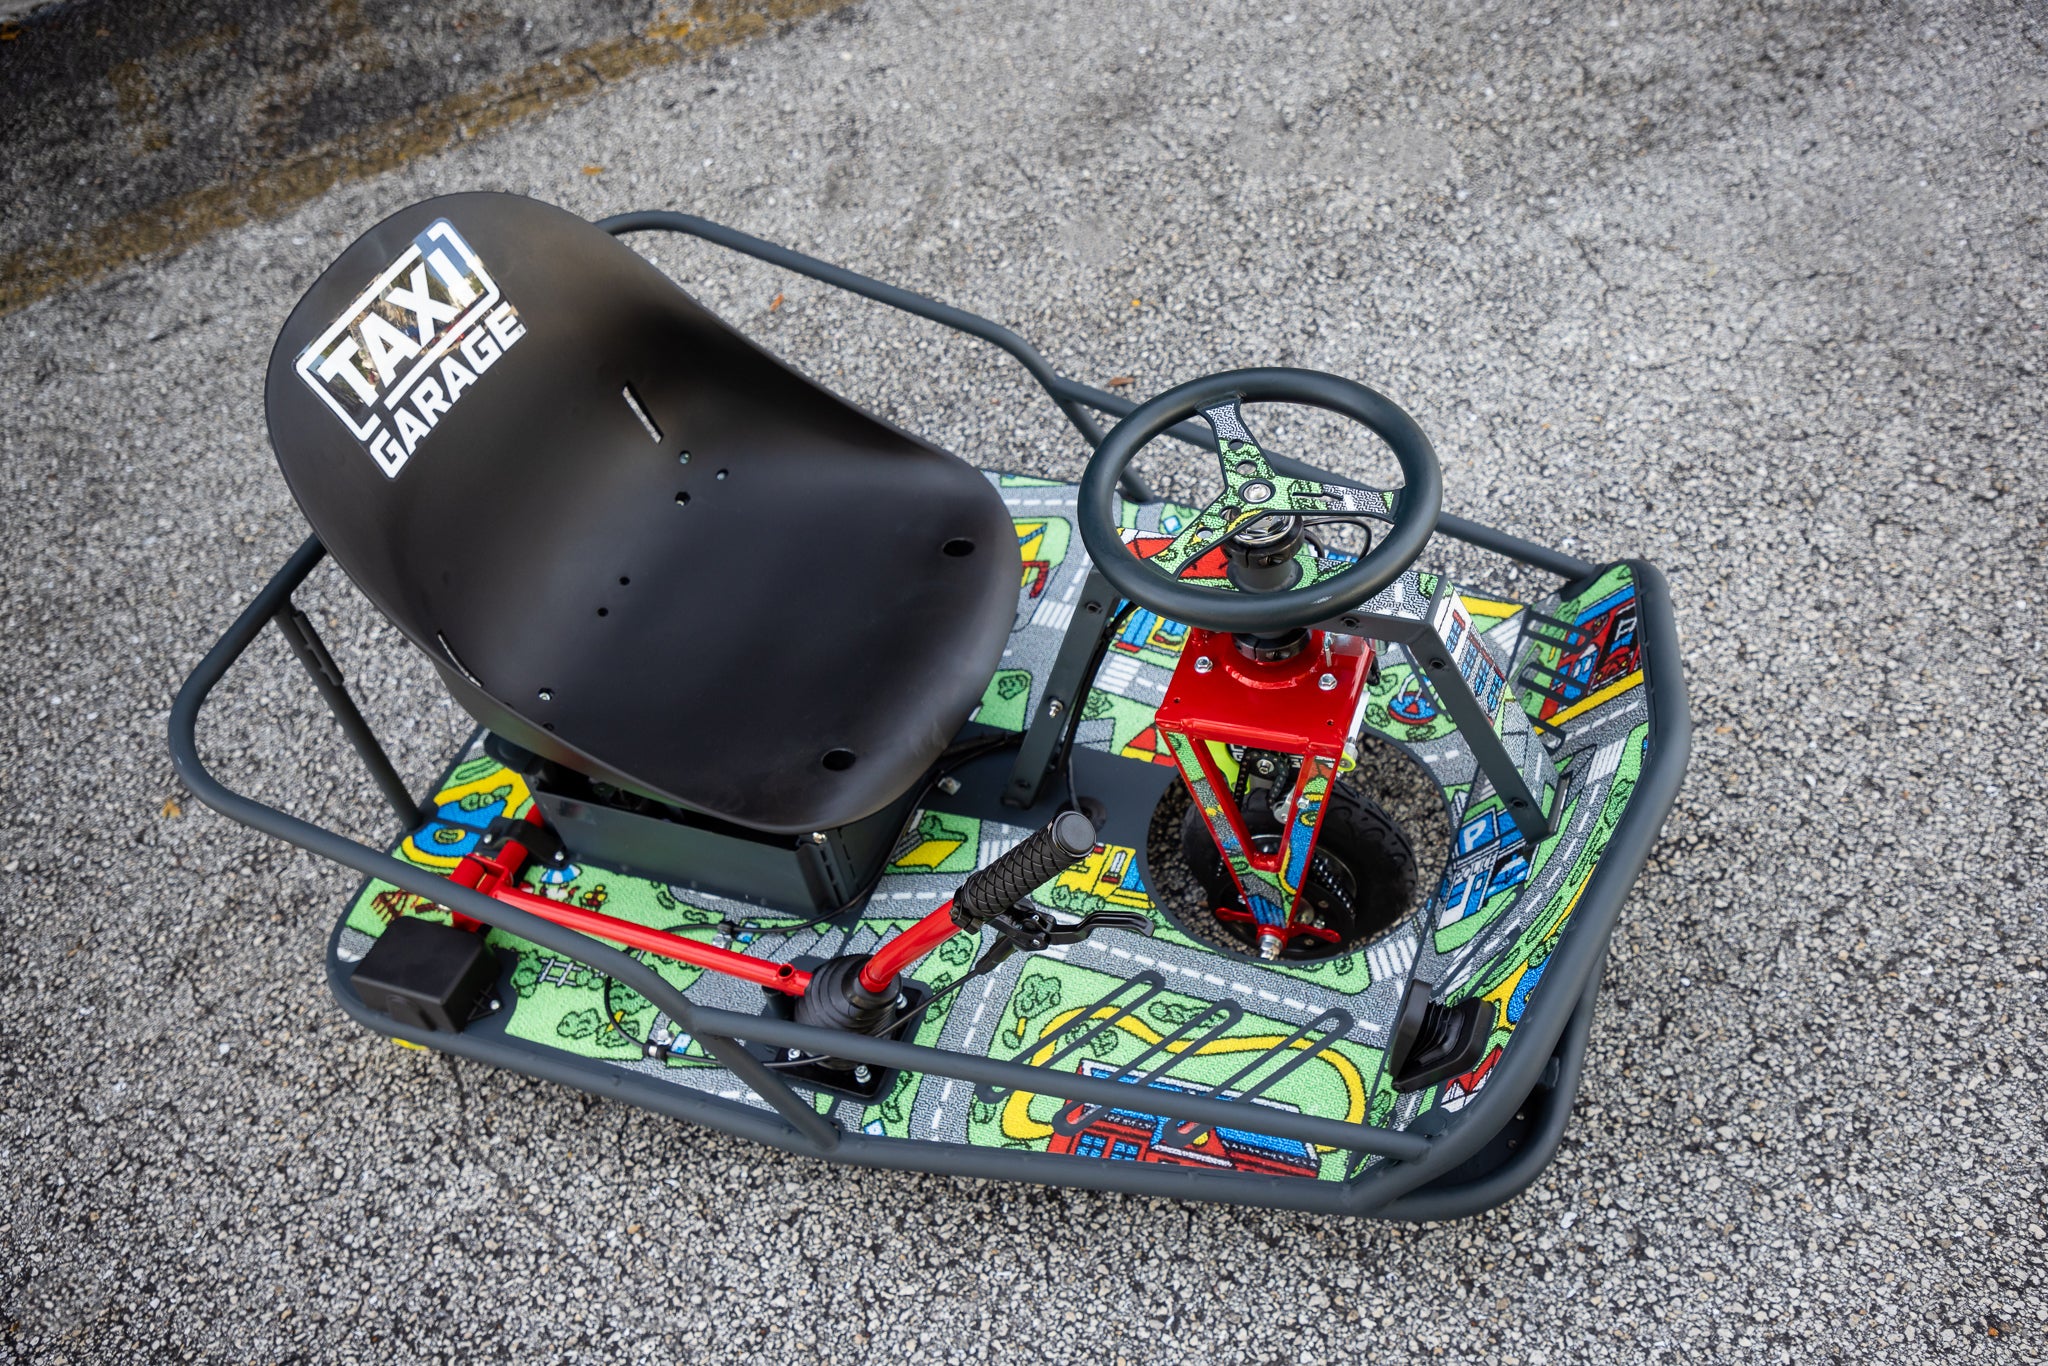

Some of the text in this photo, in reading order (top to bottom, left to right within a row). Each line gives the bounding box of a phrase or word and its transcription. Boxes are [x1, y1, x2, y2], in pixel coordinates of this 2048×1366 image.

[318, 248, 477, 407] TAXI
[370, 301, 526, 478] GARAGE
[1463, 820, 1487, 853] P
